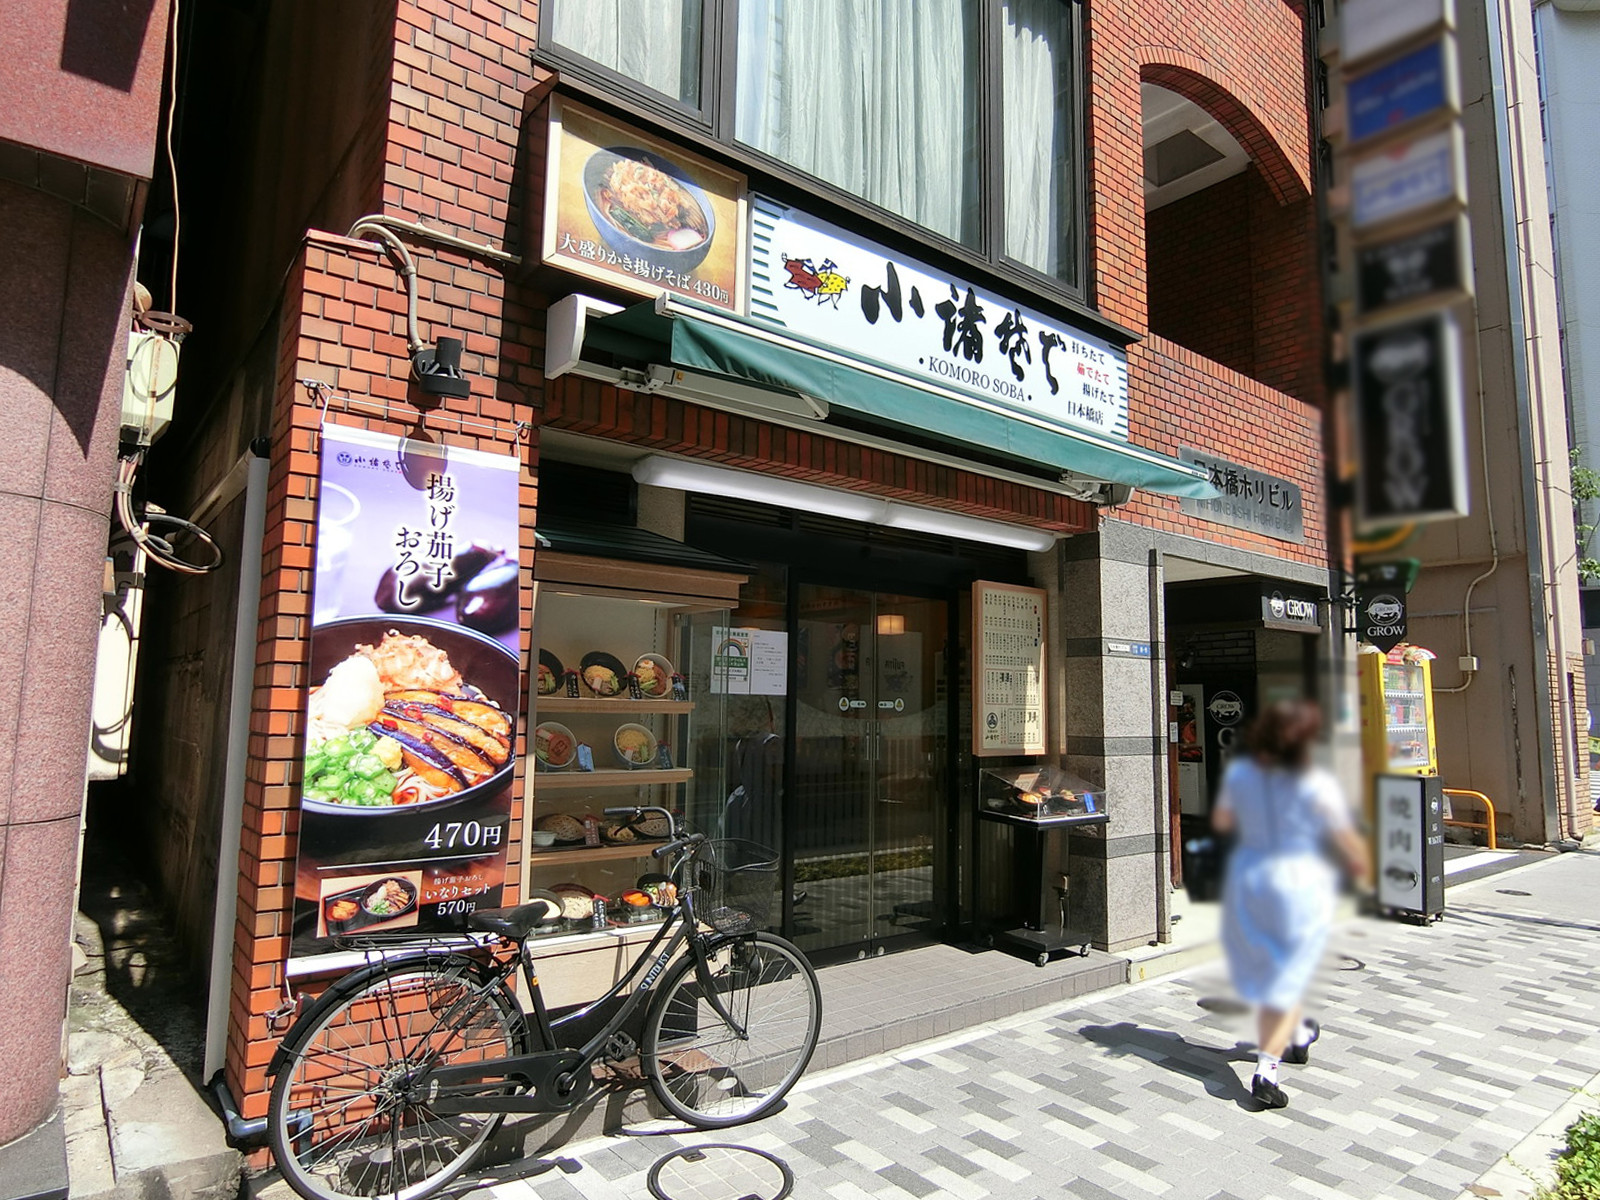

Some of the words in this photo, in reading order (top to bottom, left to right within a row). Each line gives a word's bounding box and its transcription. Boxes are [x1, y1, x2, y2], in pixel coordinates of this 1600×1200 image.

[559, 233, 691, 291] 大盛りかき揚げそば
[692, 278, 730, 304] 430円
[1071, 340, 1105, 365] 打ちたて
[928, 355, 991, 390] KOMORO
[991, 377, 1025, 403] SOBA
[1082, 382, 1115, 406] 揚げたて
[1067, 400, 1104, 426] 日本橋店
[425, 473, 456, 589] 揚げ茄子
[395, 526, 423, 607] おろし
[1286, 599, 1315, 618] GROW
[1366, 625, 1406, 637] GROW
[424, 820, 503, 850] 470円
[426, 883, 491, 899] いなりセット
[437, 899, 477, 916] 570円
